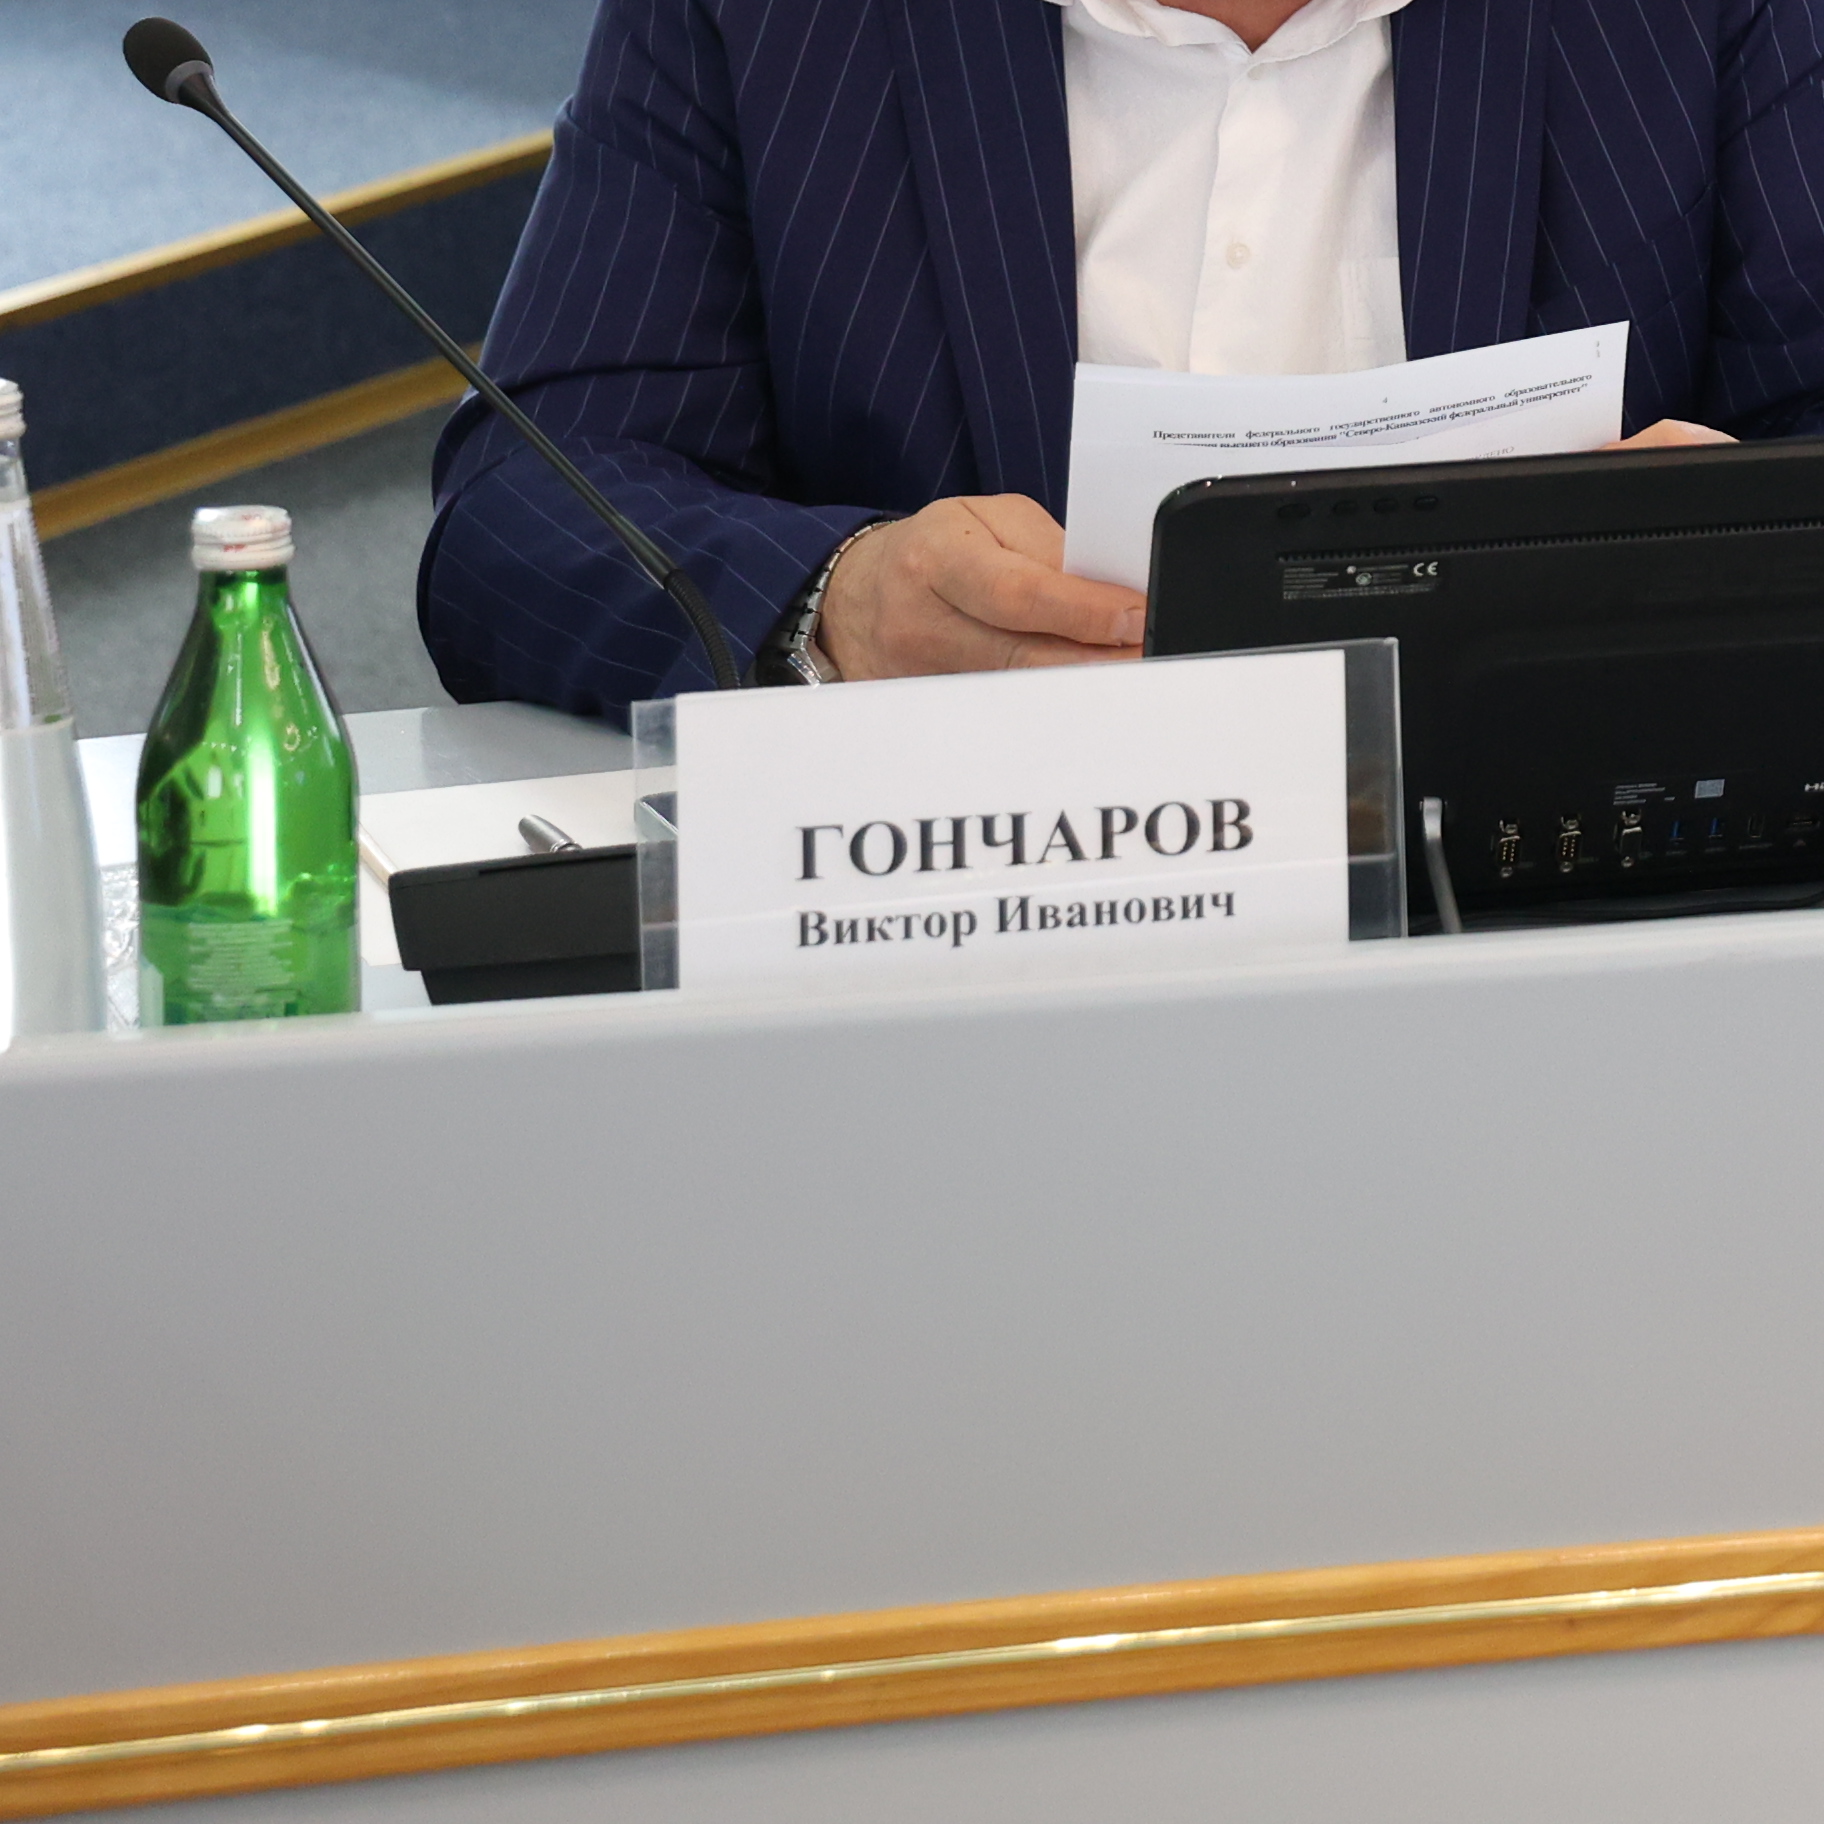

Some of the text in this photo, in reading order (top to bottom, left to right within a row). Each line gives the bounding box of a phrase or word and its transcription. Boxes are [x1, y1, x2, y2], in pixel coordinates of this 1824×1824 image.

[1152, 374, 1593, 441] Представители федерального государственного автономного образовательного
[1270, 433, 1338, 448] образования
[1449, 398, 1519, 421] федеральный
[796, 797, 1254, 882] ГОНЧАРОВ
[798, 892, 1235, 949] Виктор Иванович
